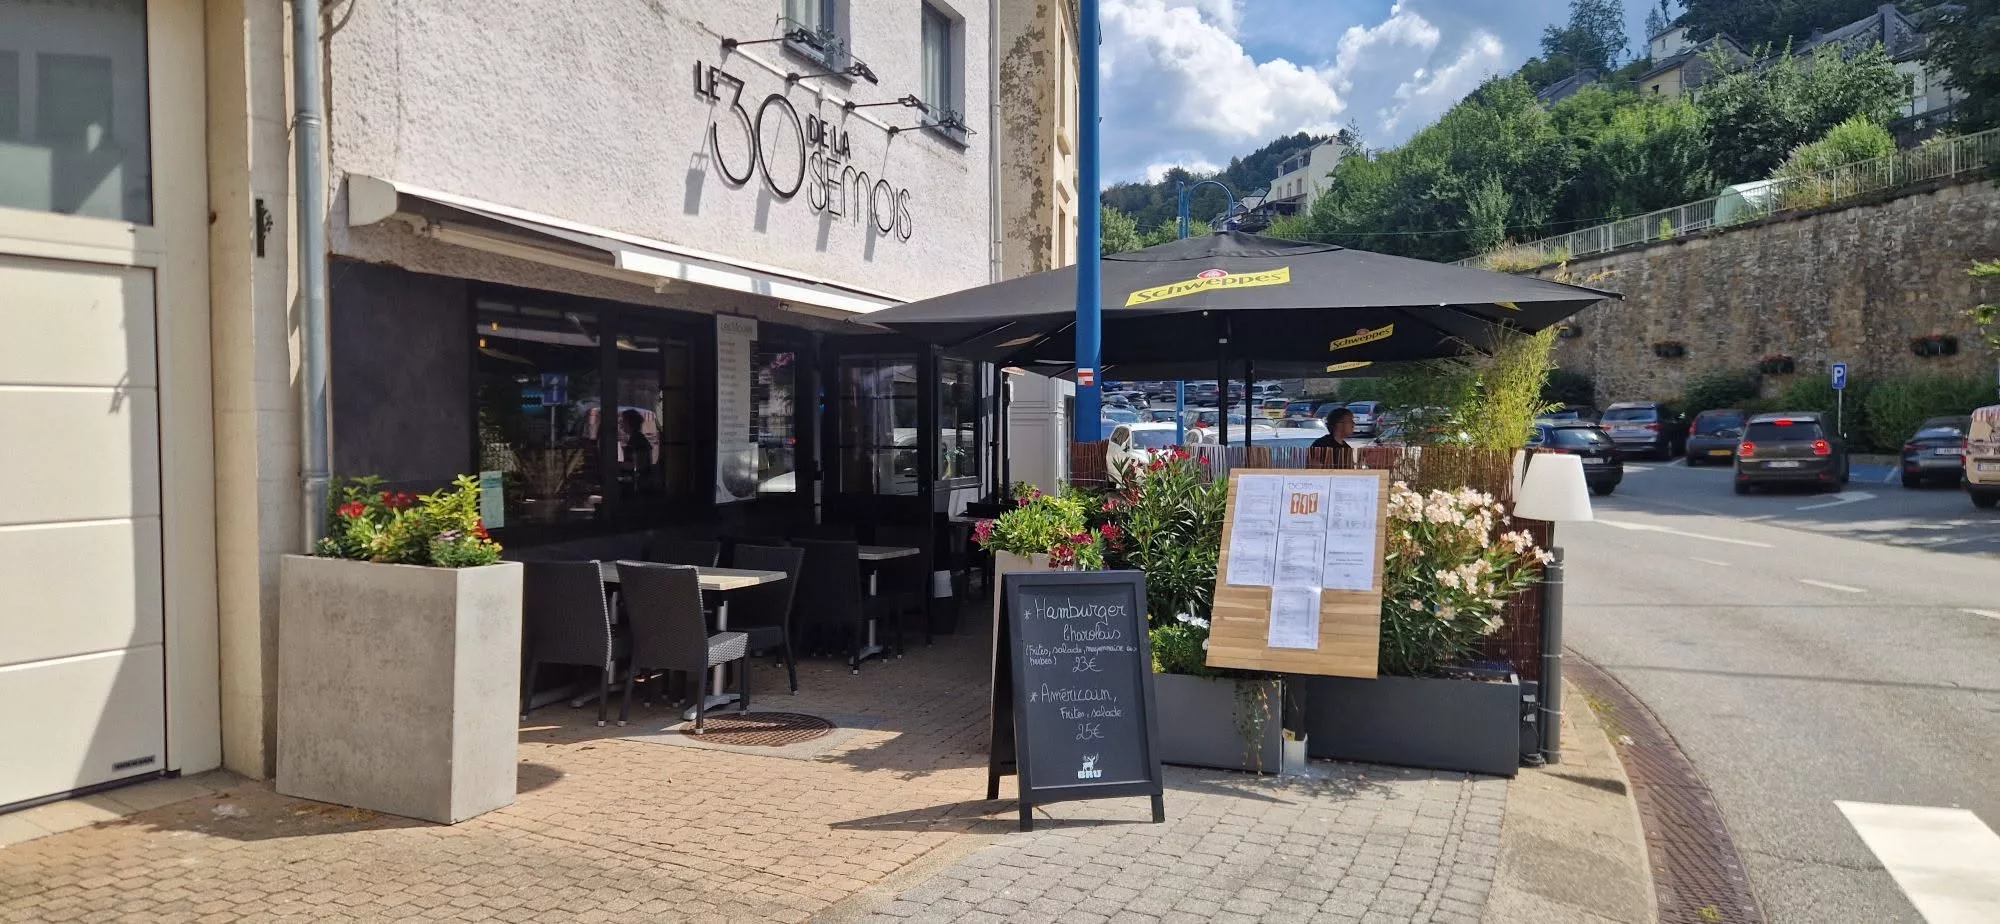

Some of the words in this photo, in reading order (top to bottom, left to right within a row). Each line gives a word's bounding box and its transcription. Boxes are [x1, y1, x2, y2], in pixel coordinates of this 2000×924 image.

[697, 60, 721, 101] LE
[713, 68, 805, 198] 30
[809, 114, 830, 150] DE
[833, 125, 851, 160] LA
[810, 151, 912, 240] SEMOIS
[1135, 272, 1283, 302] Schweppes
[1332, 328, 1390, 349] Schweppes
[1834, 367, 1843, 384] P
[1034, 597, 1127, 625] Hamburger
[1072, 656, 1103, 672] 23€
[1075, 723, 1105, 740] 25€
[1077, 770, 1102, 779] BRU
